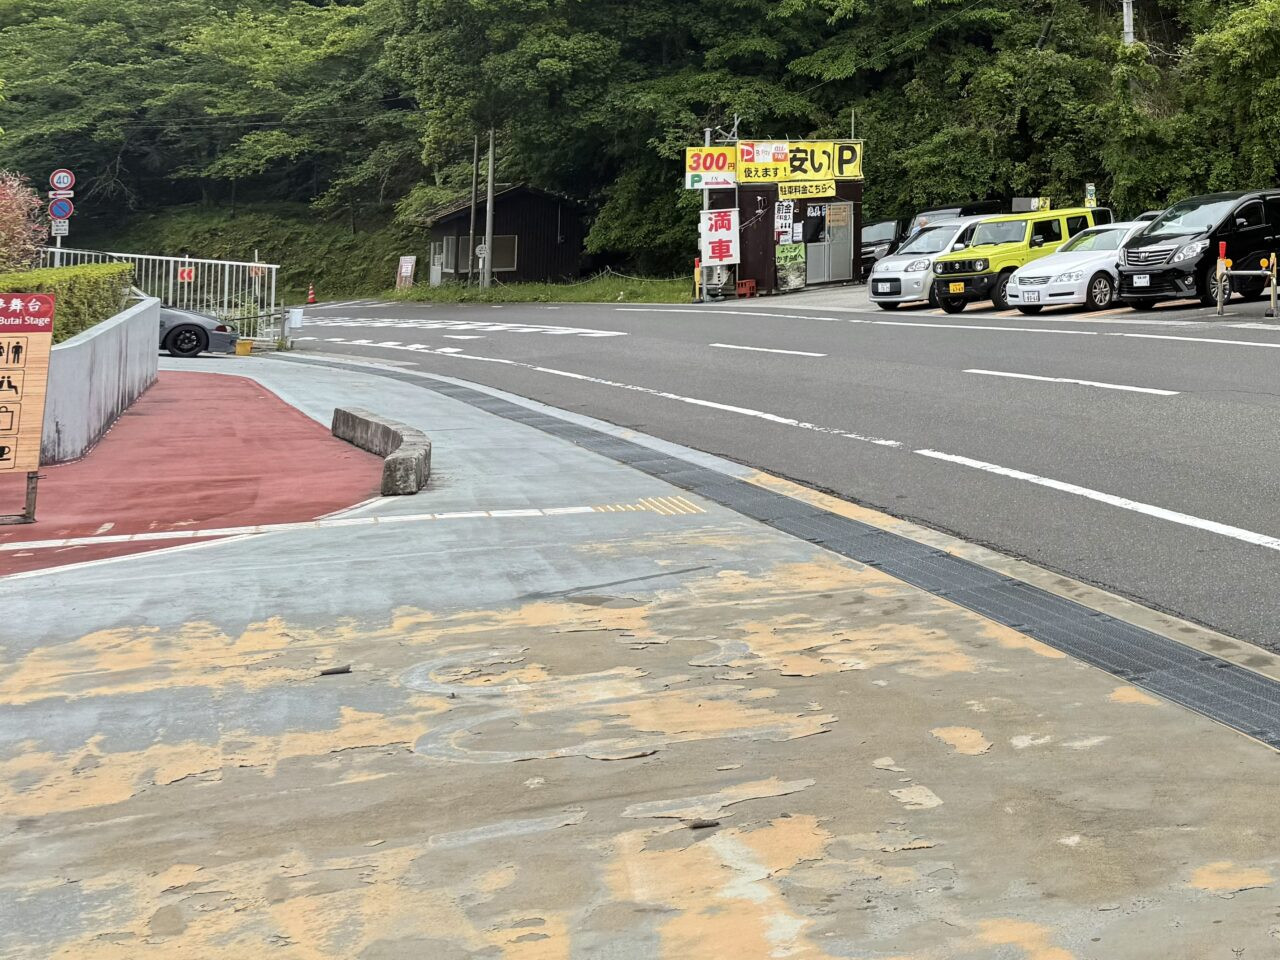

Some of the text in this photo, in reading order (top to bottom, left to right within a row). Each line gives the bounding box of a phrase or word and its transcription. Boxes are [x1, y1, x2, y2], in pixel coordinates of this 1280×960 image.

[789, 145, 858, 175] 安い P
[56, 175, 69, 185] 40
[690, 174, 702, 188] P
[780, 183, 835, 196] 駐車料金こちらへ
[776, 203, 792, 214] 前金
[708, 211, 733, 262] 満車
[0, 316, 51, 327] Butai Stage
